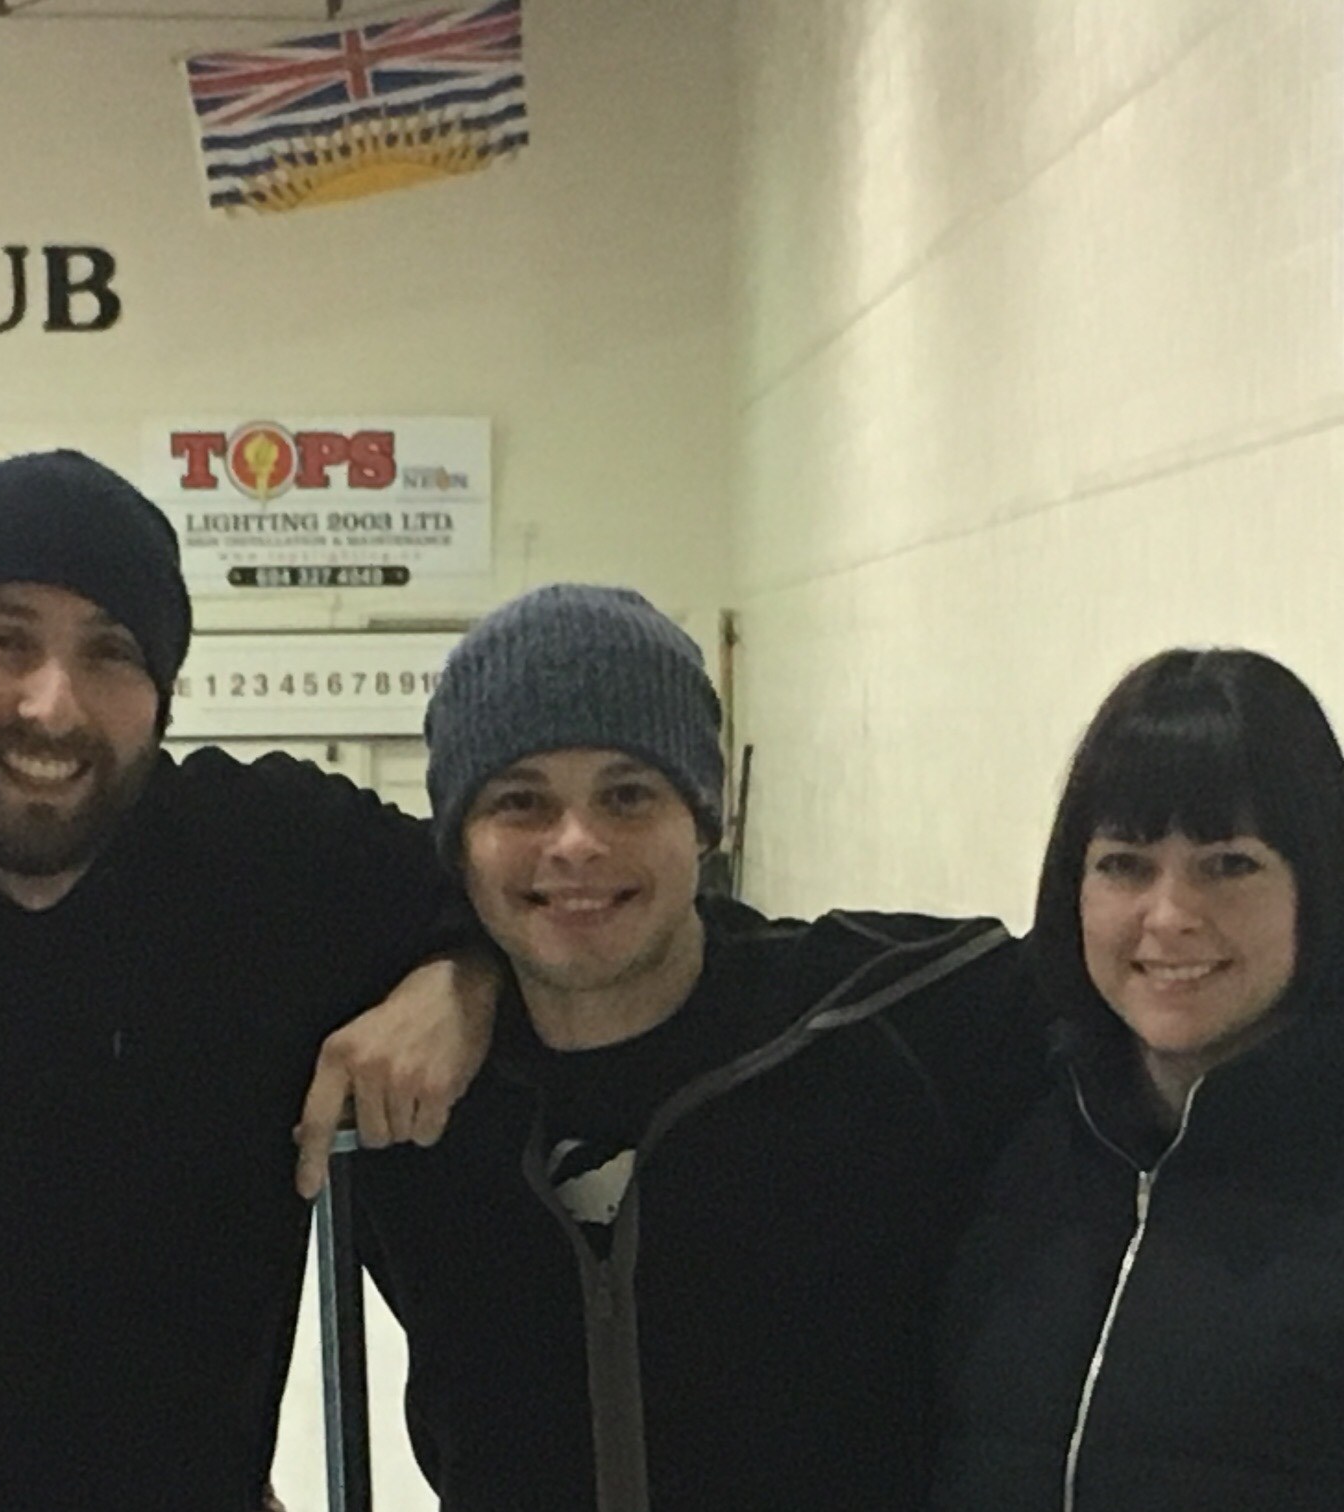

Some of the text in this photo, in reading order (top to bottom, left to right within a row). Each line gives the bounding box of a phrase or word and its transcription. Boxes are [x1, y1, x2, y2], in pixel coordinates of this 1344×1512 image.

[170, 420, 397, 499] TOPS
[186, 513, 319, 533] LIGHTING
[206, 674, 217, 696] 1
[230, 673, 245, 696] 2
[253, 673, 268, 696] 3
[280, 673, 295, 696] 4
[303, 673, 318, 696] 5
[327, 673, 342, 696] 6
[351, 673, 366, 695] 7
[375, 671, 390, 695] 8
[399, 671, 415, 695] 9
